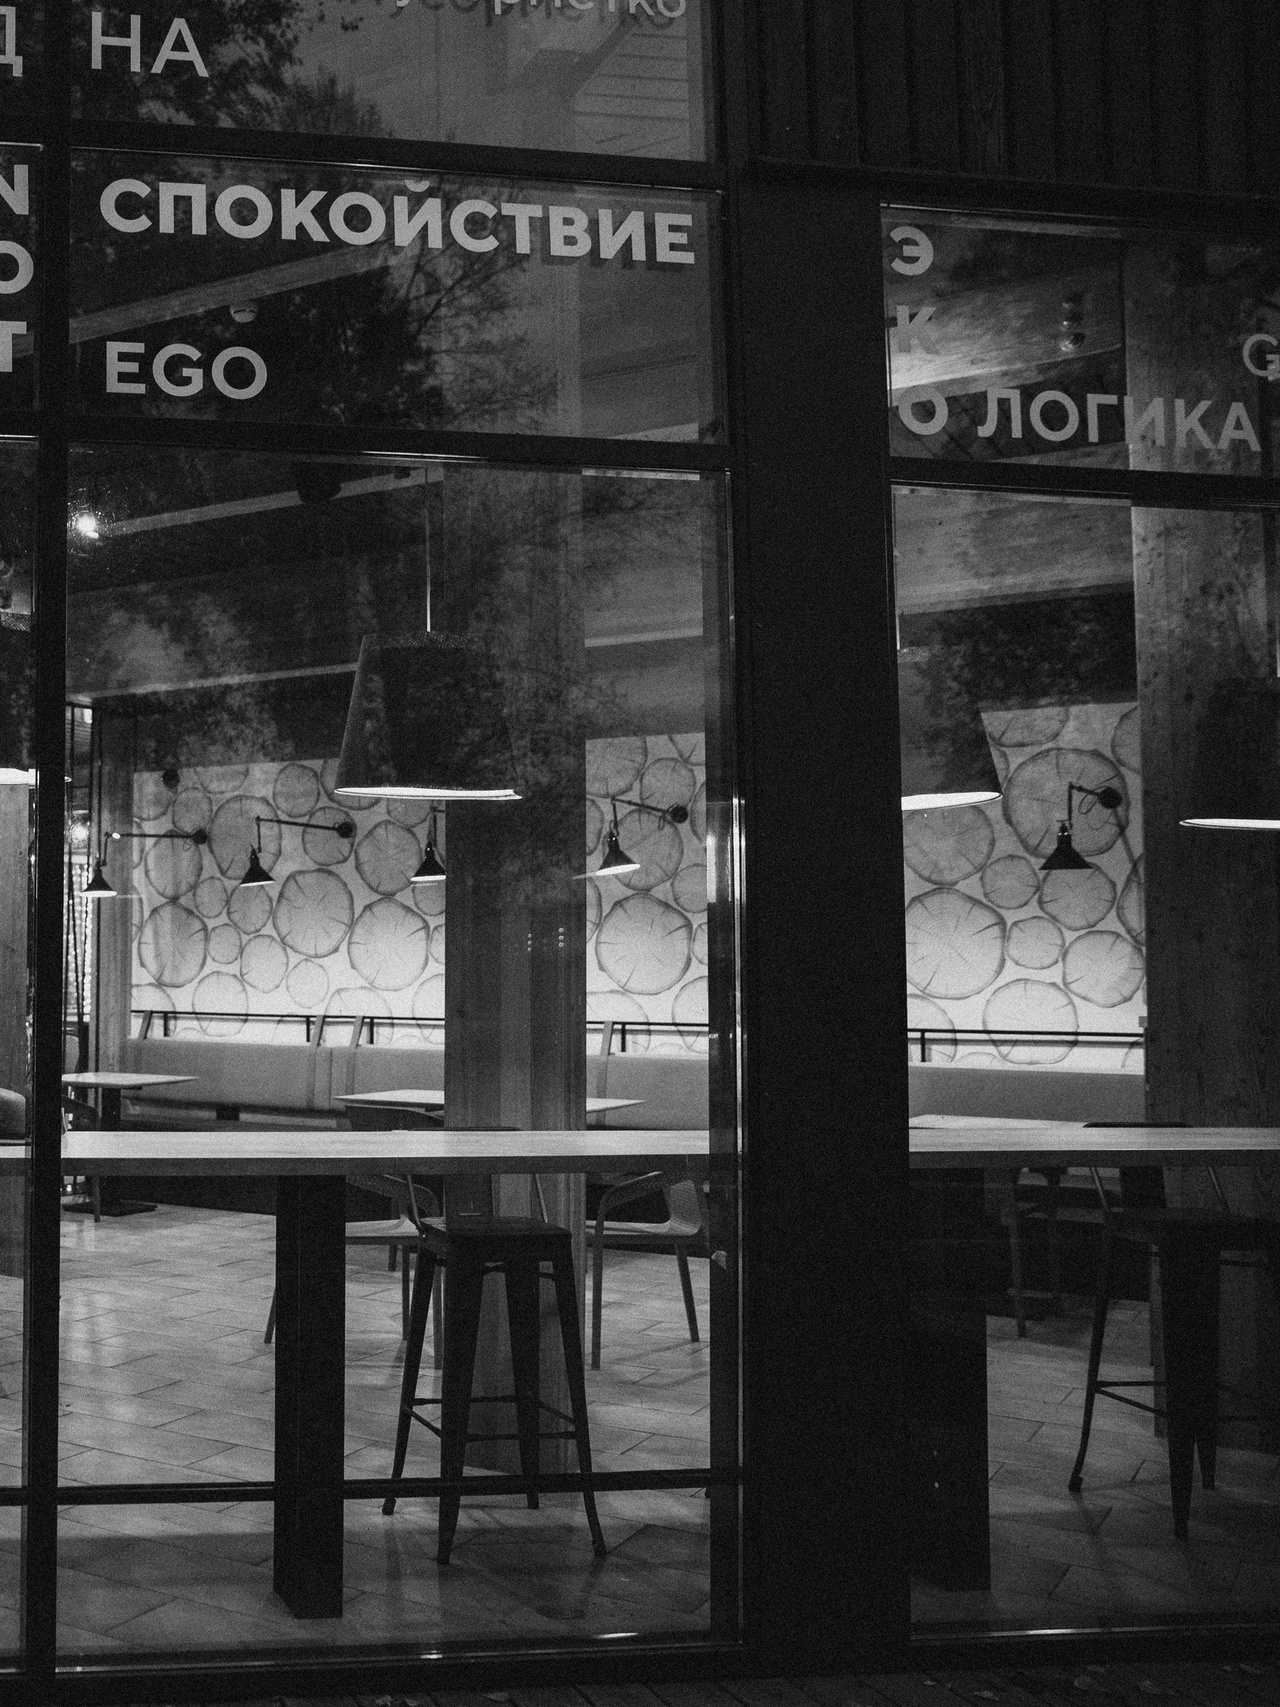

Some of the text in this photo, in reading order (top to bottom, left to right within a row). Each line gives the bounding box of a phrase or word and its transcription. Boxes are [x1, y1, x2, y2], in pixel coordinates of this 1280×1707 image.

[91, 11, 209, 77] НА
[99, 179, 695, 264] СПОКОЙСТВИЕ
[106, 341, 267, 400] EGO
